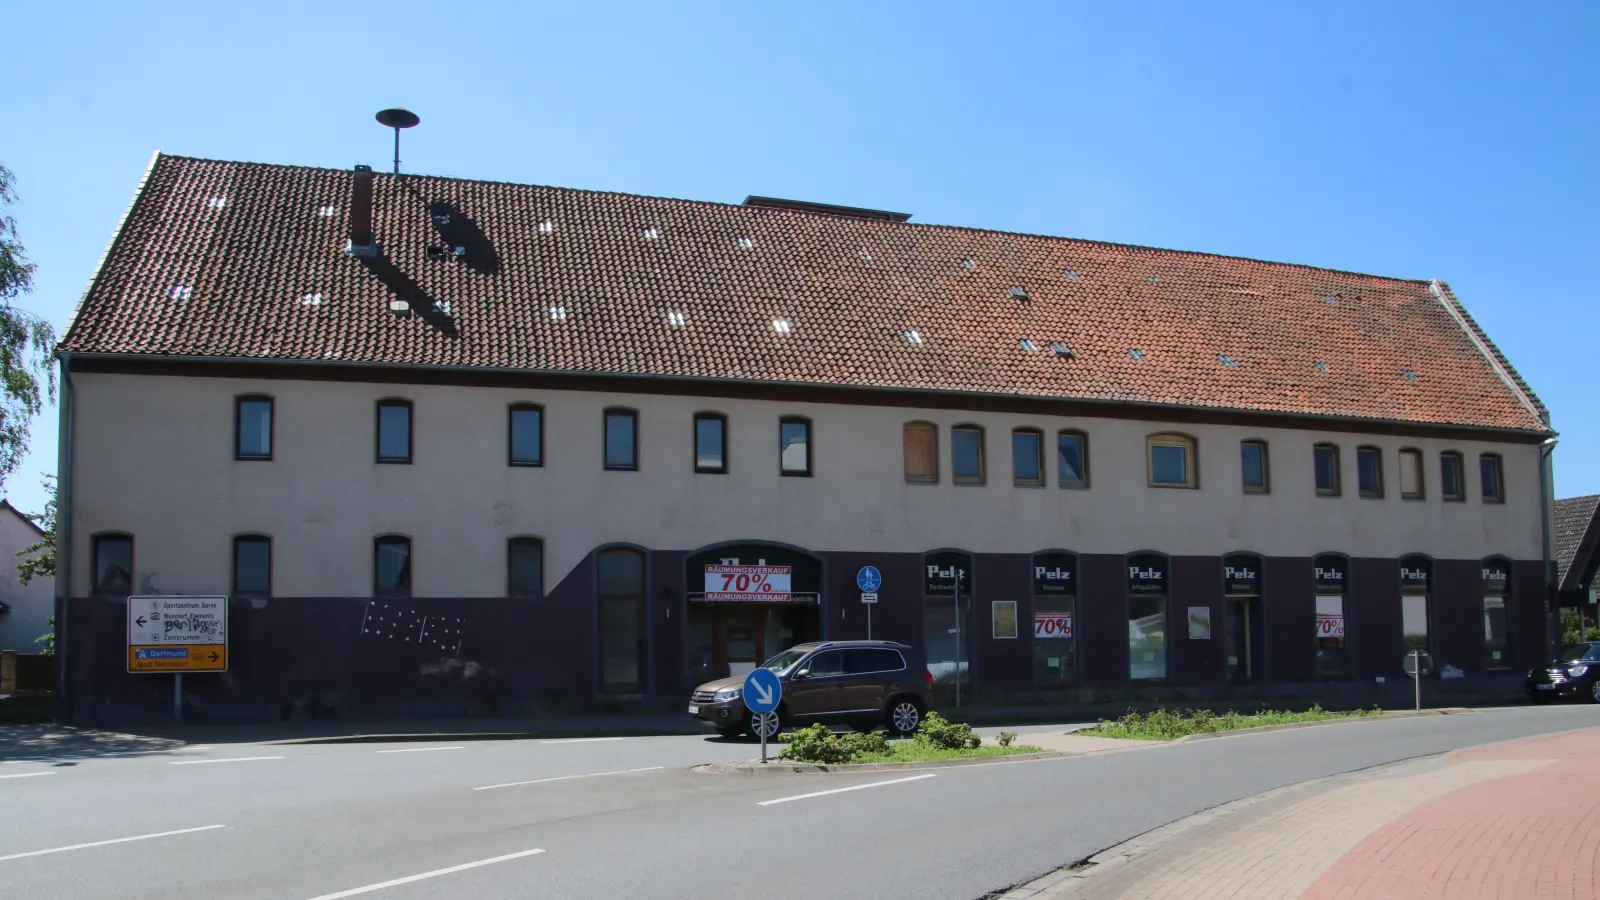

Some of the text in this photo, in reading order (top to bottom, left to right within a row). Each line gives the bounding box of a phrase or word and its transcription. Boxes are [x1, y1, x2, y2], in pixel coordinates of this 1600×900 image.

[707, 566, 789, 574] RÄUMUNGSVERKAUF
[1035, 566, 1071, 579] Pelz
[1128, 566, 1162, 579] Pelz
[1224, 566, 1256, 579] Pelz
[1314, 567, 1343, 580] Pelz
[1400, 567, 1428, 580] Pelz
[1481, 568, 1508, 580] Pelz
[721, 573, 772, 593] 70%
[707, 592, 789, 601] RÄUMUNGSVERKAUF
[1035, 619, 1072, 634] 70%
[1316, 619, 1345, 634] 70%
[150, 649, 187, 657] Dortmund
